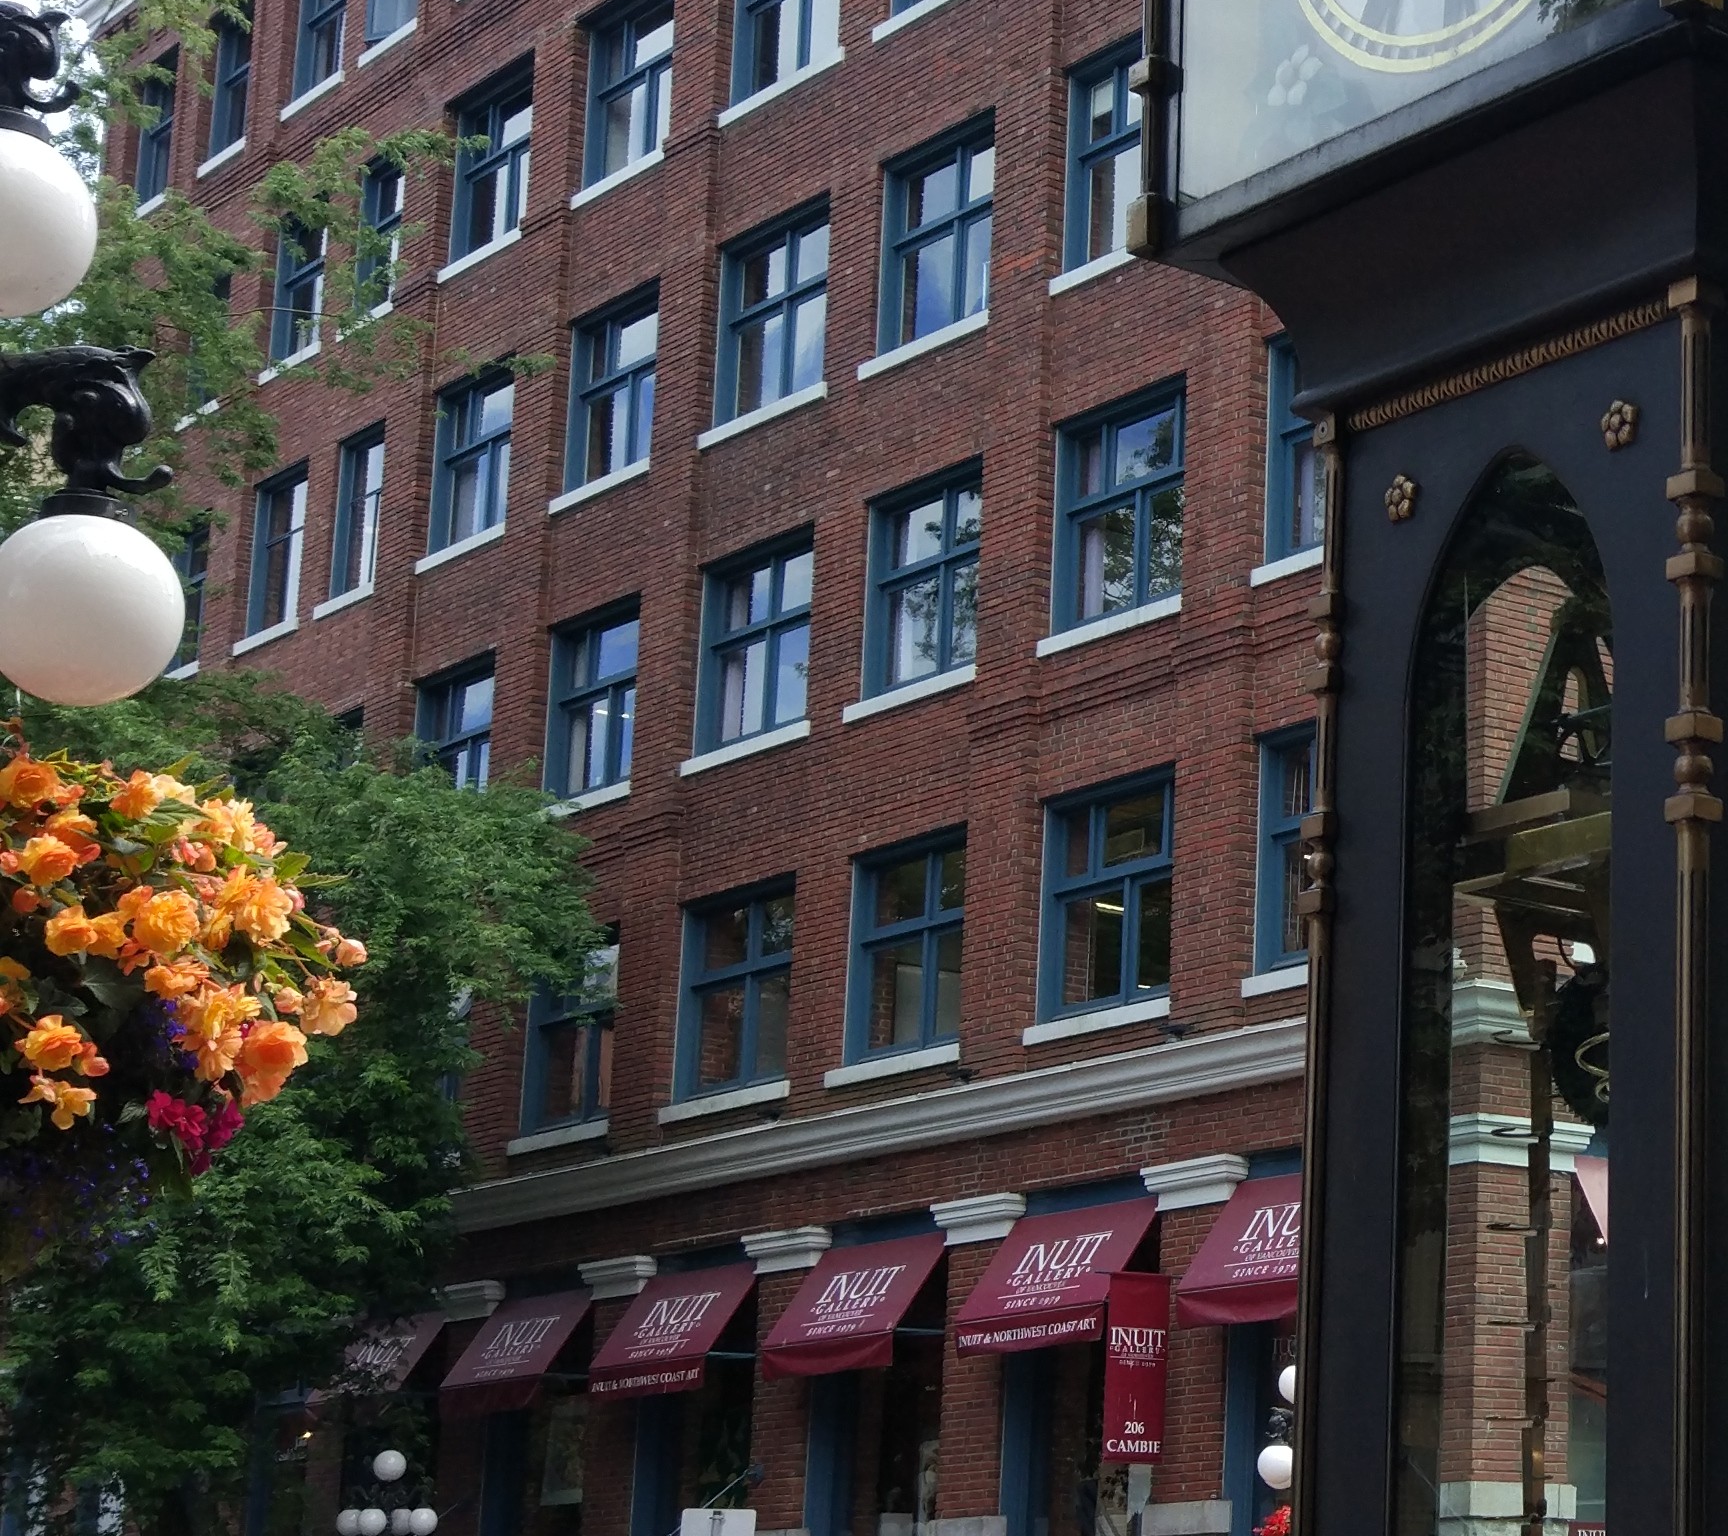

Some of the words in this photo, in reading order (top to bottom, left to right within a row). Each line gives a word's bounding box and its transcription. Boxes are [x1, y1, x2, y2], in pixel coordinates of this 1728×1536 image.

[1012, 1230, 1113, 1276] INUIT
[817, 1265, 906, 1304] INUIT
[1011, 1266, 1083, 1286] GALLERY
[640, 1292, 721, 1327] INUIT
[816, 1296, 878, 1314] GALLERY
[1004, 1298, 1035, 1310] SINCE
[487, 1317, 560, 1349] INUIT
[637, 1323, 697, 1339] GALLERY
[958, 1334, 982, 1348] INUIT
[993, 1326, 1047, 1343] NORTHWEST
[1048, 1322, 1076, 1335] COAST
[1076, 1318, 1097, 1330] ART
[1110, 1327, 1166, 1348] INUIT
[1124, 1422, 1144, 1435] 206
[1107, 1439, 1161, 1454] CAMBIE
